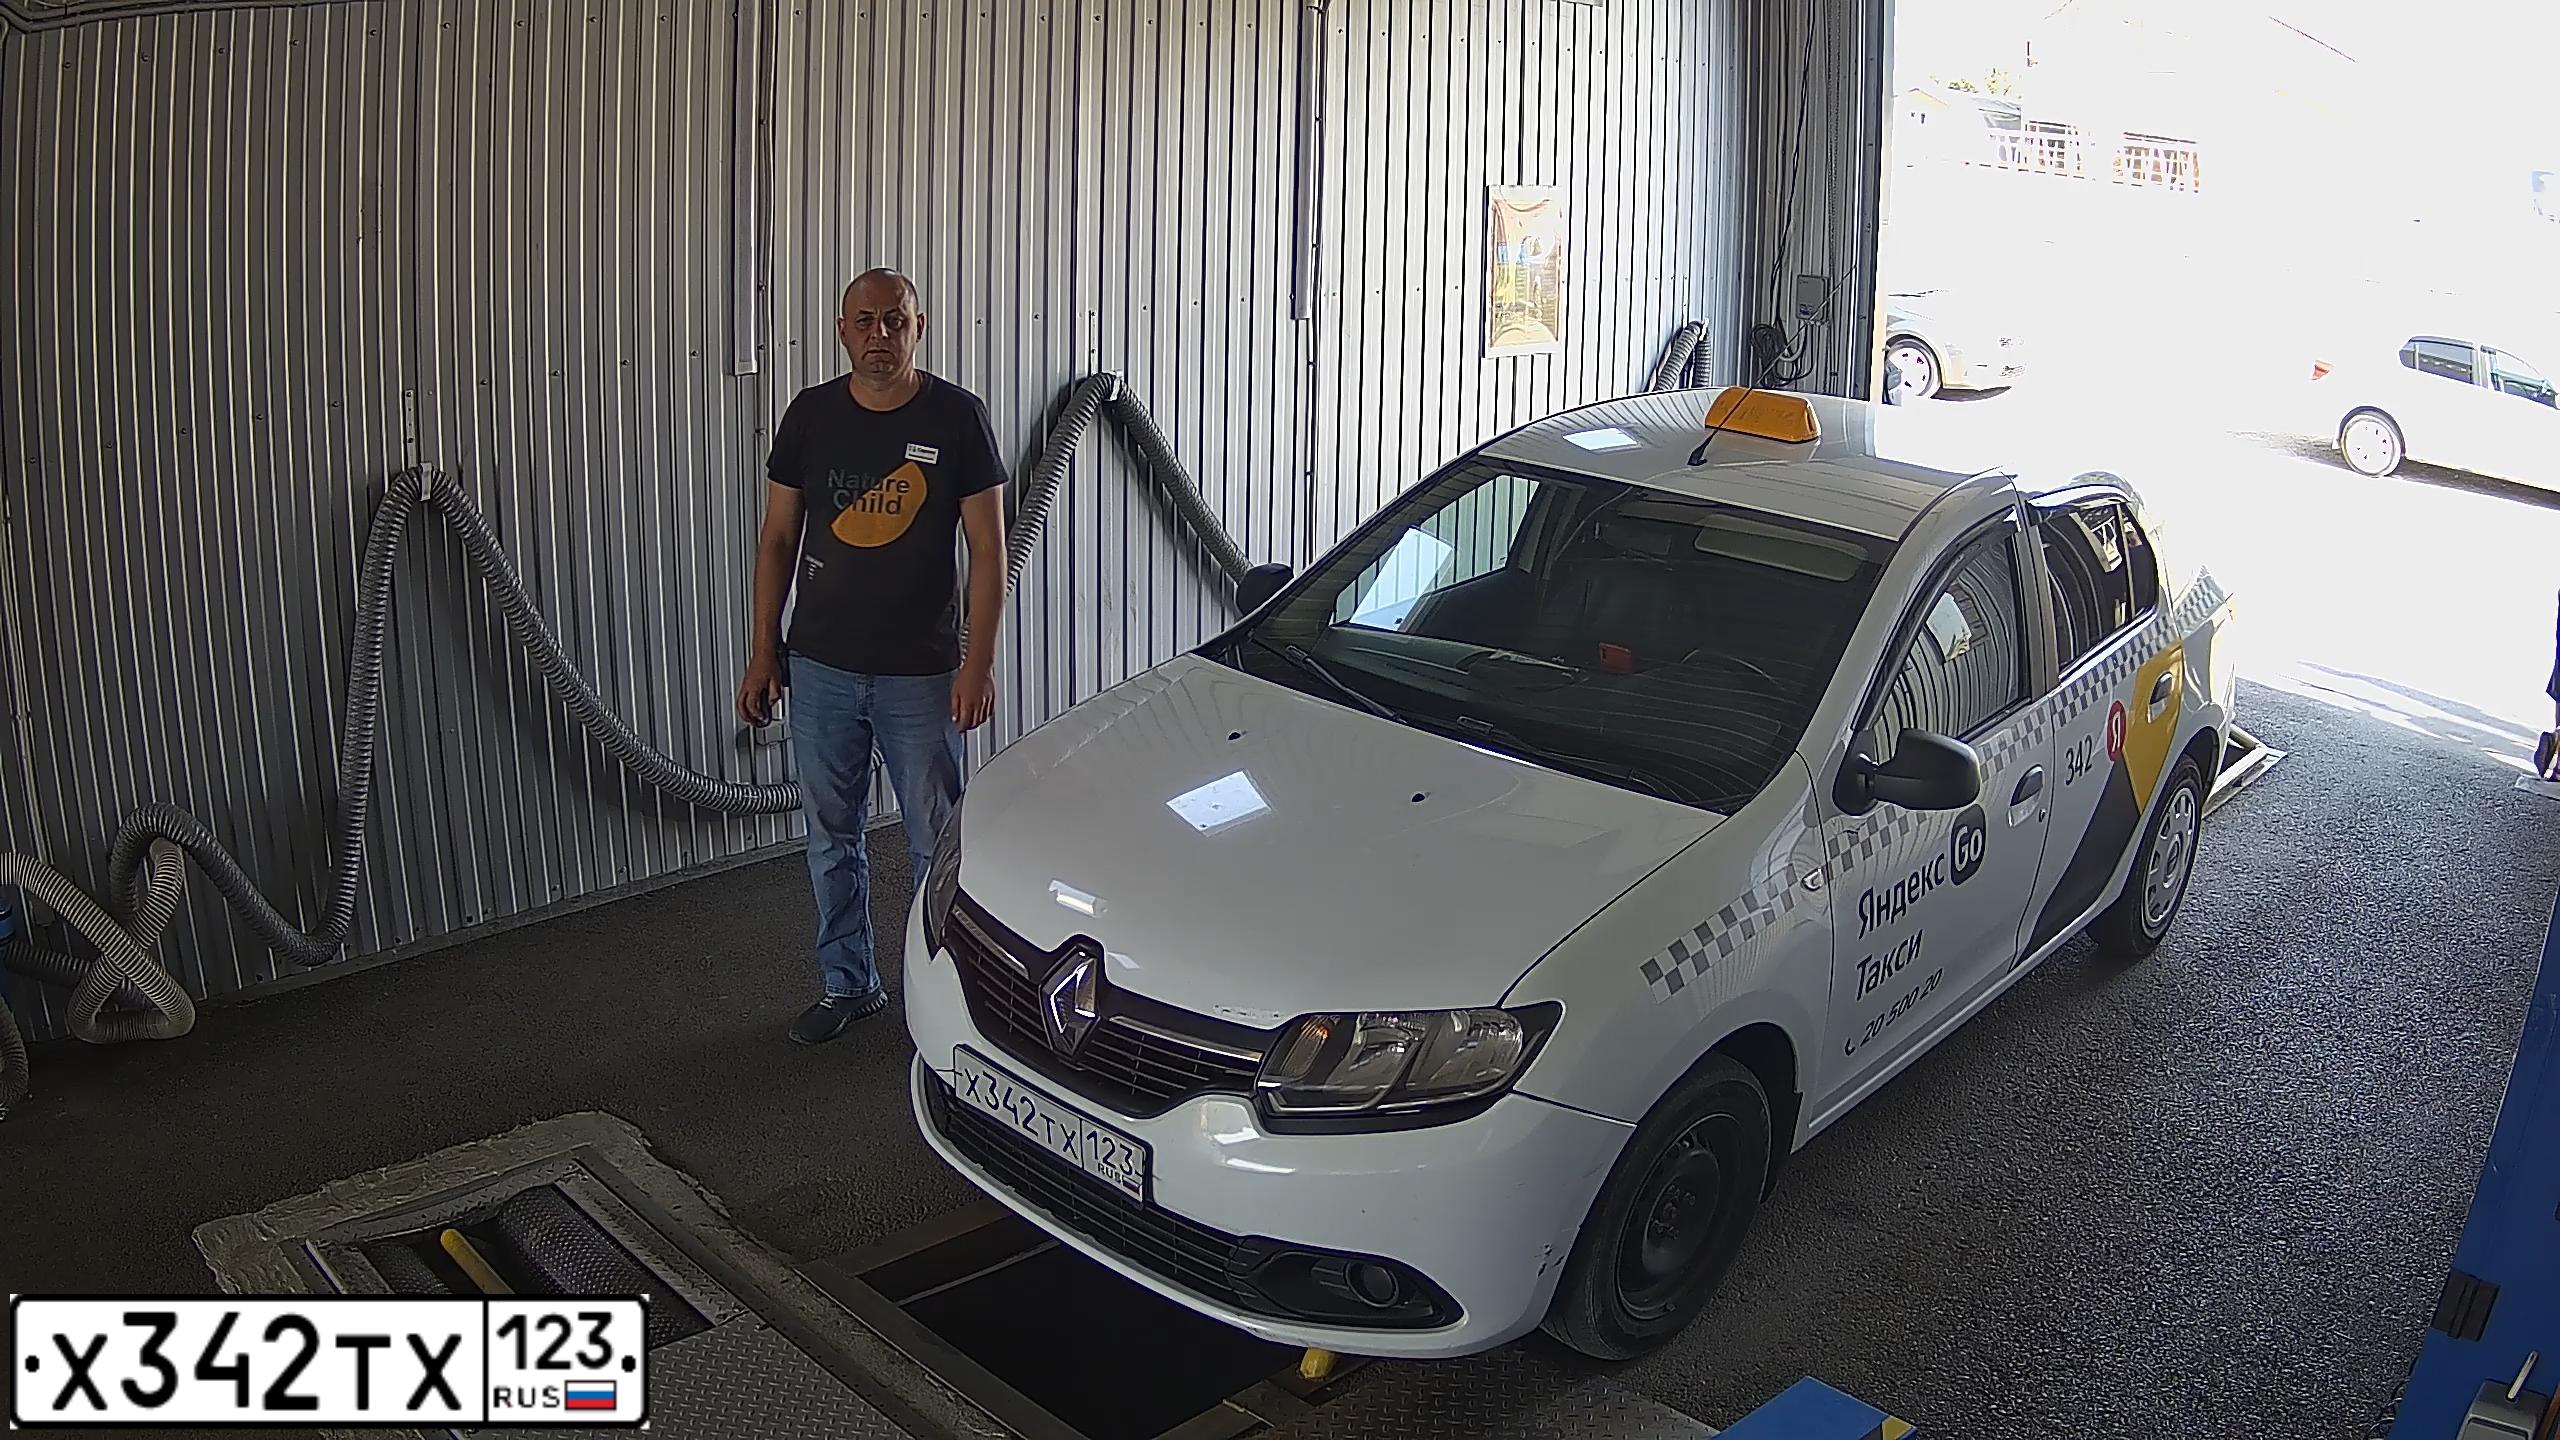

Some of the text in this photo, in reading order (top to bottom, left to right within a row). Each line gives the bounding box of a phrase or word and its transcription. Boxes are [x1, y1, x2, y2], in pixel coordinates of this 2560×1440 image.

[828, 469, 910, 494] Nature
[833, 488, 902, 515] Child
[2112, 711, 2121, 752] Я
[2066, 734, 2092, 786] 342
[1859, 826, 1983, 939] Яндекс Go
[1857, 929, 1923, 1000] Такси
[1860, 968, 1943, 1047] 20 500 20
[1086, 1130, 1132, 1175] 123
